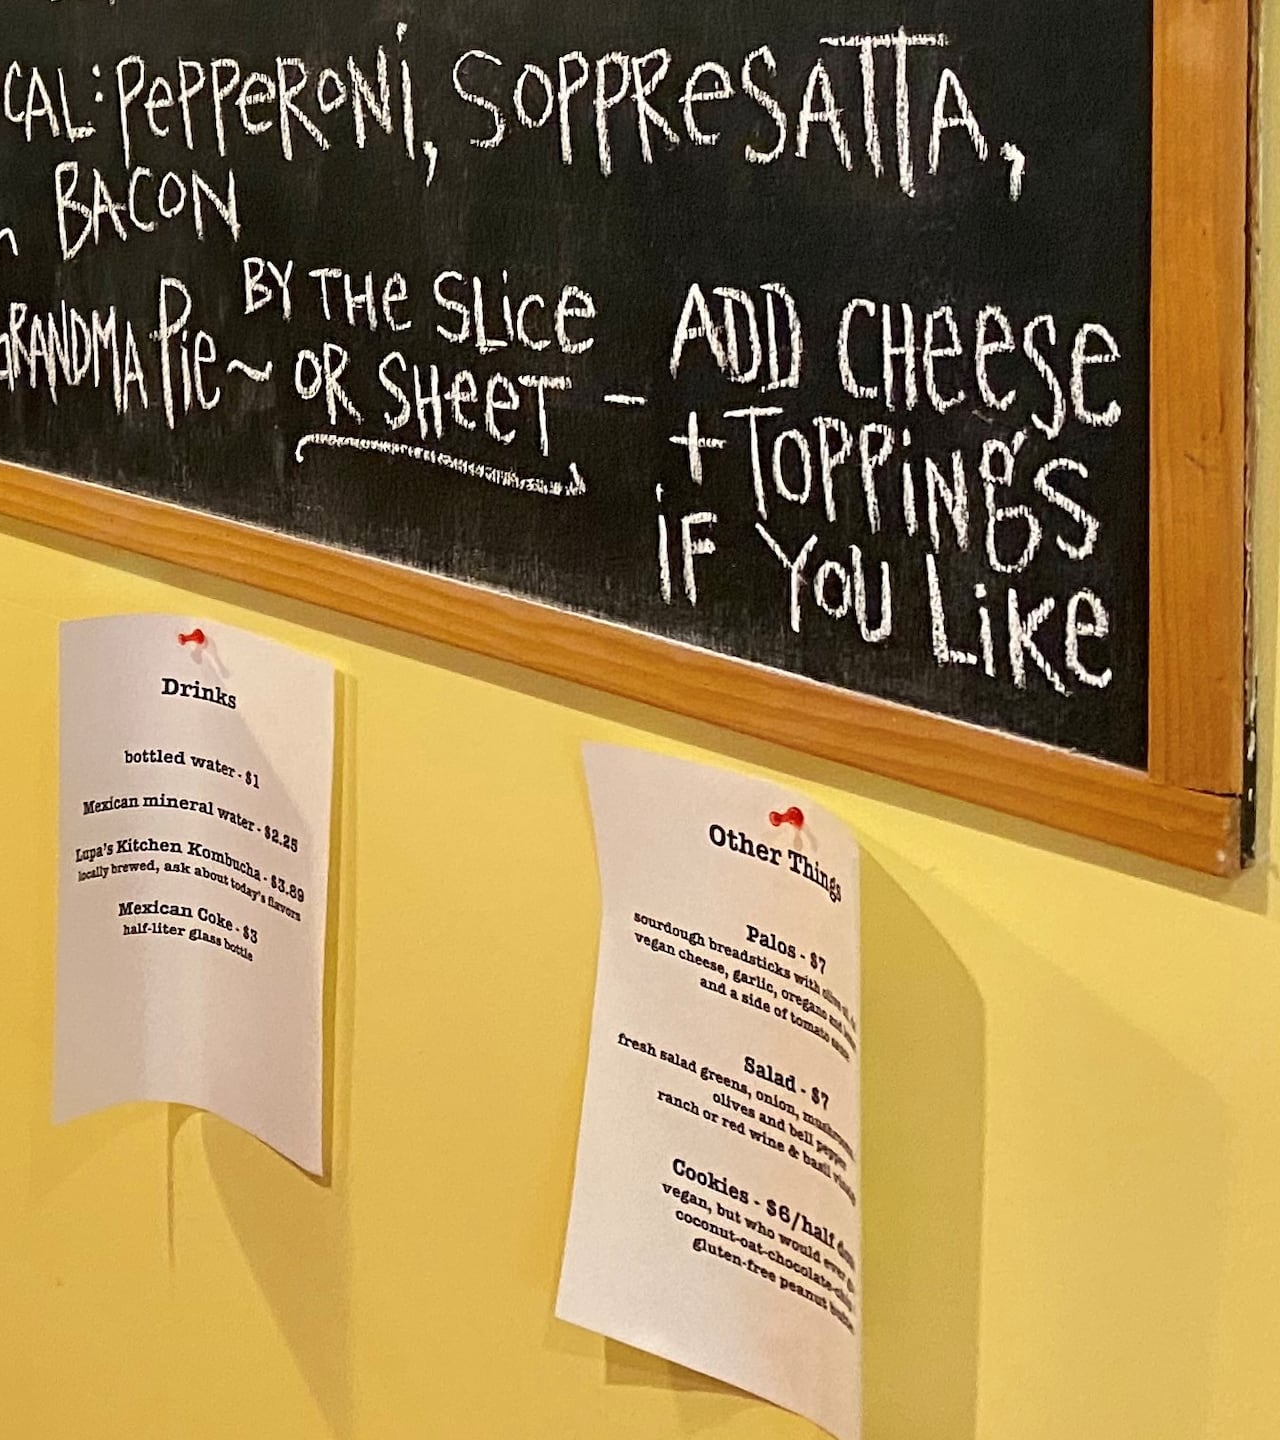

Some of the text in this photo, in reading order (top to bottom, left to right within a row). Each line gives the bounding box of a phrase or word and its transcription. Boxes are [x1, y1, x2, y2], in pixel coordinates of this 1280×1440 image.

[54, 161, 239, 264] BACON
[242, 257, 292, 322] BY
[670, 282, 803, 393] ADD
[293, 341, 364, 426] OR
[755, 522, 892, 644] YOU
[161, 677, 237, 709] Drinks
[124, 749, 260, 789] bottled water $1
[83, 793, 298, 853] Mexican mineral water $2.25
[75, 838, 305, 904] Lupa's Kitchen Kombucha $3.89
[78, 860, 301, 922] locally brewed, ask about today's flavors
[709, 824, 842, 904] Other Things
[118, 900, 258, 945] Mexican Coke $3
[123, 923, 253, 962] half-liter glass bottle
[634, 911, 820, 995] sourdough breadsticks with
[746, 924, 826, 975] Palos $7
[634, 932, 676, 957] vegan
[678, 948, 729, 979] cheese,
[733, 968, 778, 998] garlic,
[781, 987, 827, 1022] oregano
[741, 991, 829, 1044] side tomato
[617, 1032, 800, 1121] fresh salad greens, onion,
[744, 1056, 830, 1111] Salad $7
[657, 1089, 785, 1153] ranch red wine
[712, 1092, 813, 1147] olives and bell
[662, 1182, 821, 1264] vegan, but who would
[672, 1157, 836, 1251] Cookies $6/half
[692, 1237, 827, 1309] gluten-free peanut
